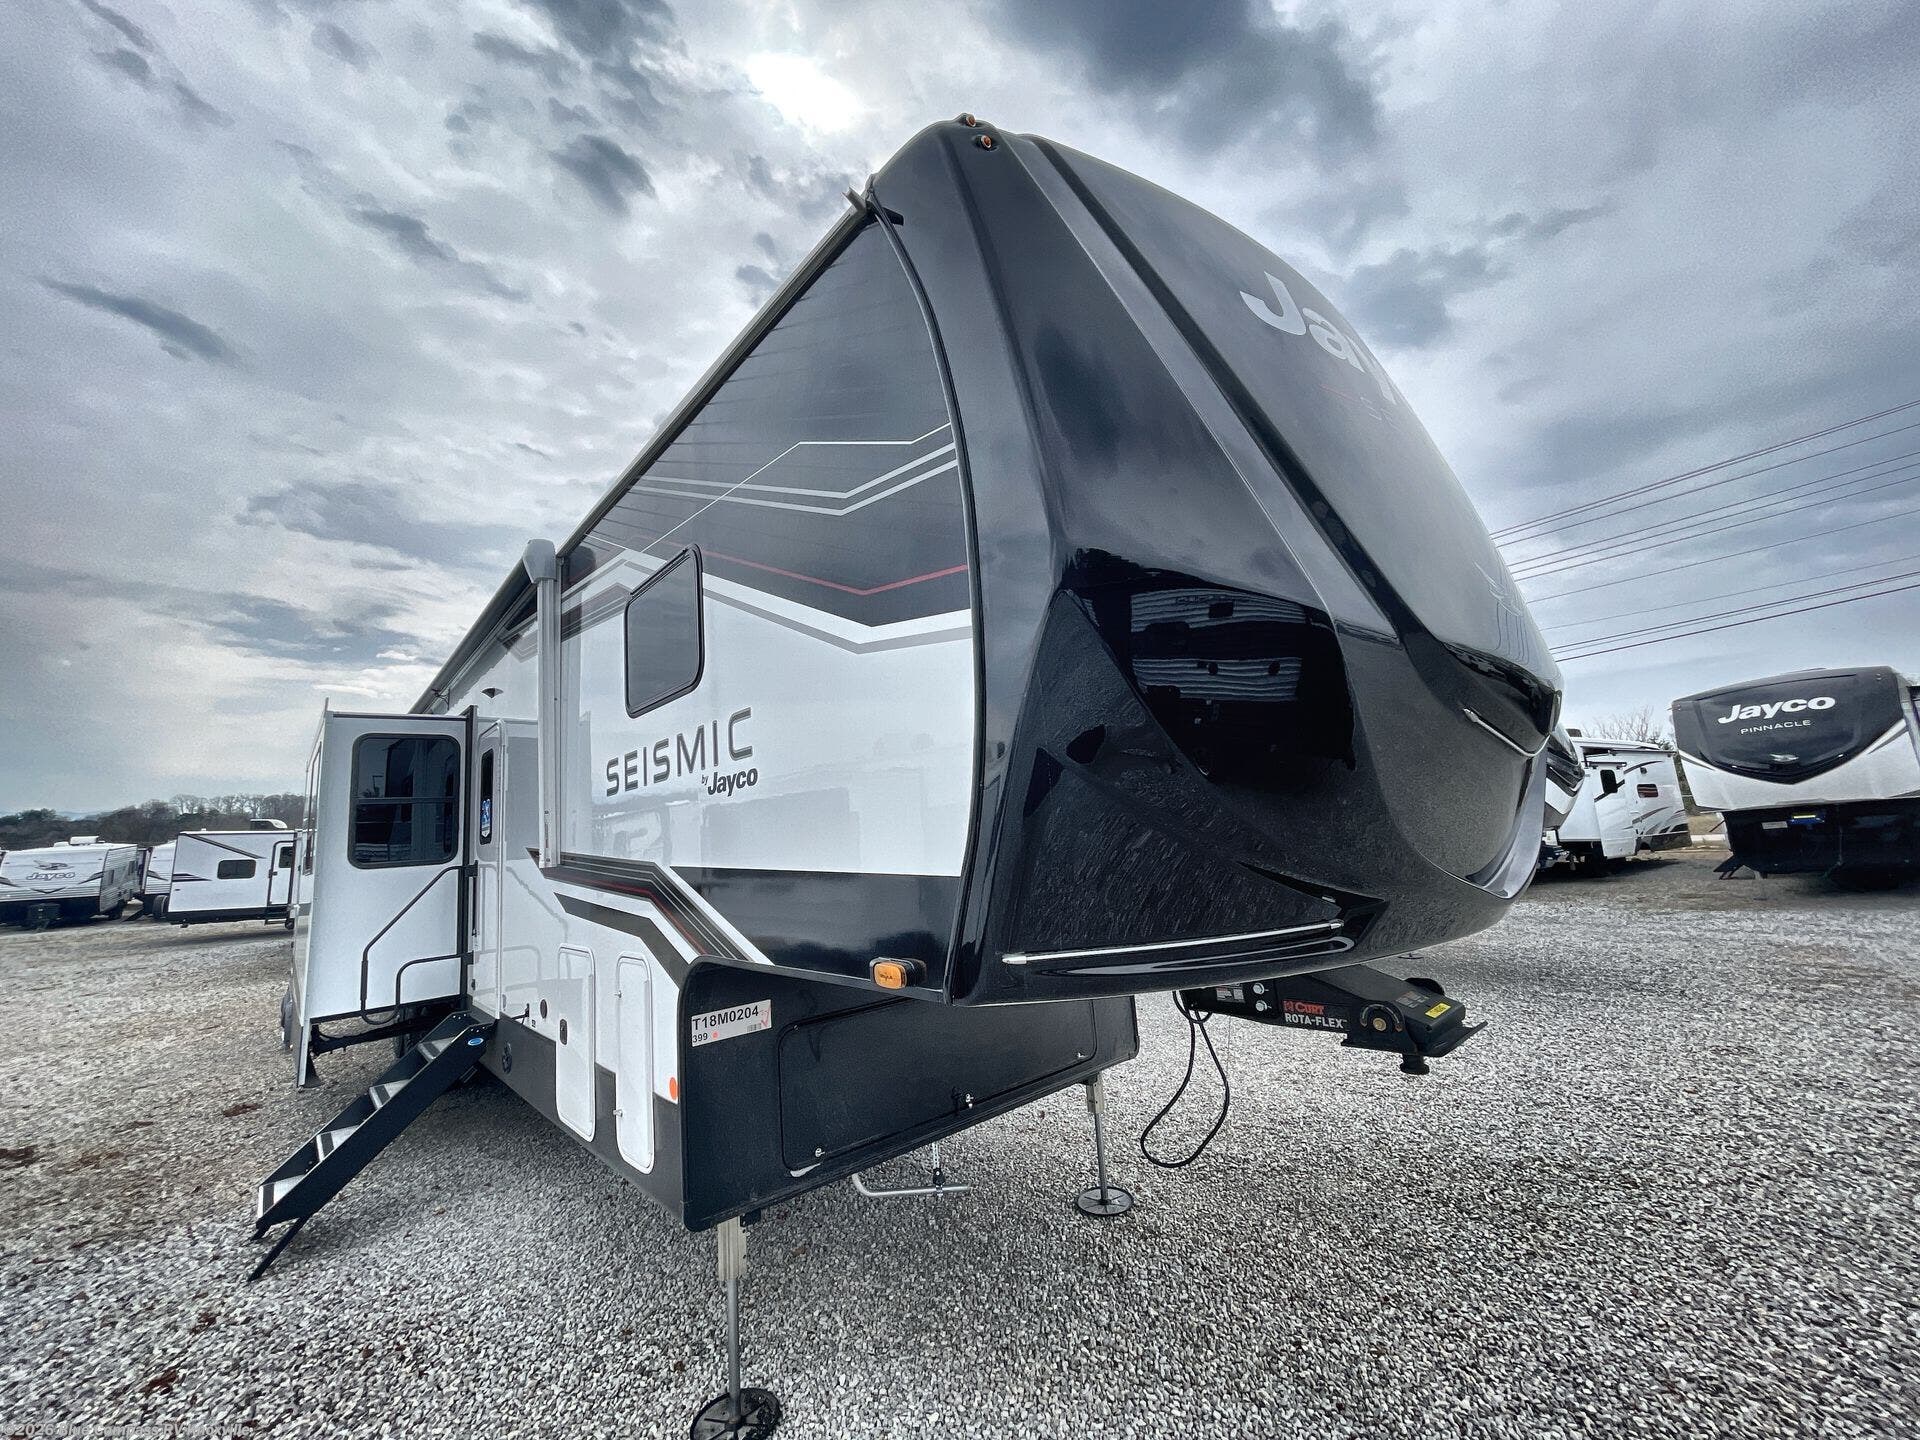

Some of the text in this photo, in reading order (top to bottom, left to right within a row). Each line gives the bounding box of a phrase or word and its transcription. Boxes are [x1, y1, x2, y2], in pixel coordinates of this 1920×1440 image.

[1718, 697, 1836, 724] Jayco
[1740, 719, 1812, 735] PINNACLE
[606, 706, 753, 797] SEISMIC
[701, 768, 758, 797] by Jayco
[26, 872, 76, 881] Jayco
[693, 1005, 759, 1031] T18M0204
[1284, 1012, 1344, 1029] ROTA-FLEX
[693, 1032, 708, 1043] 399
